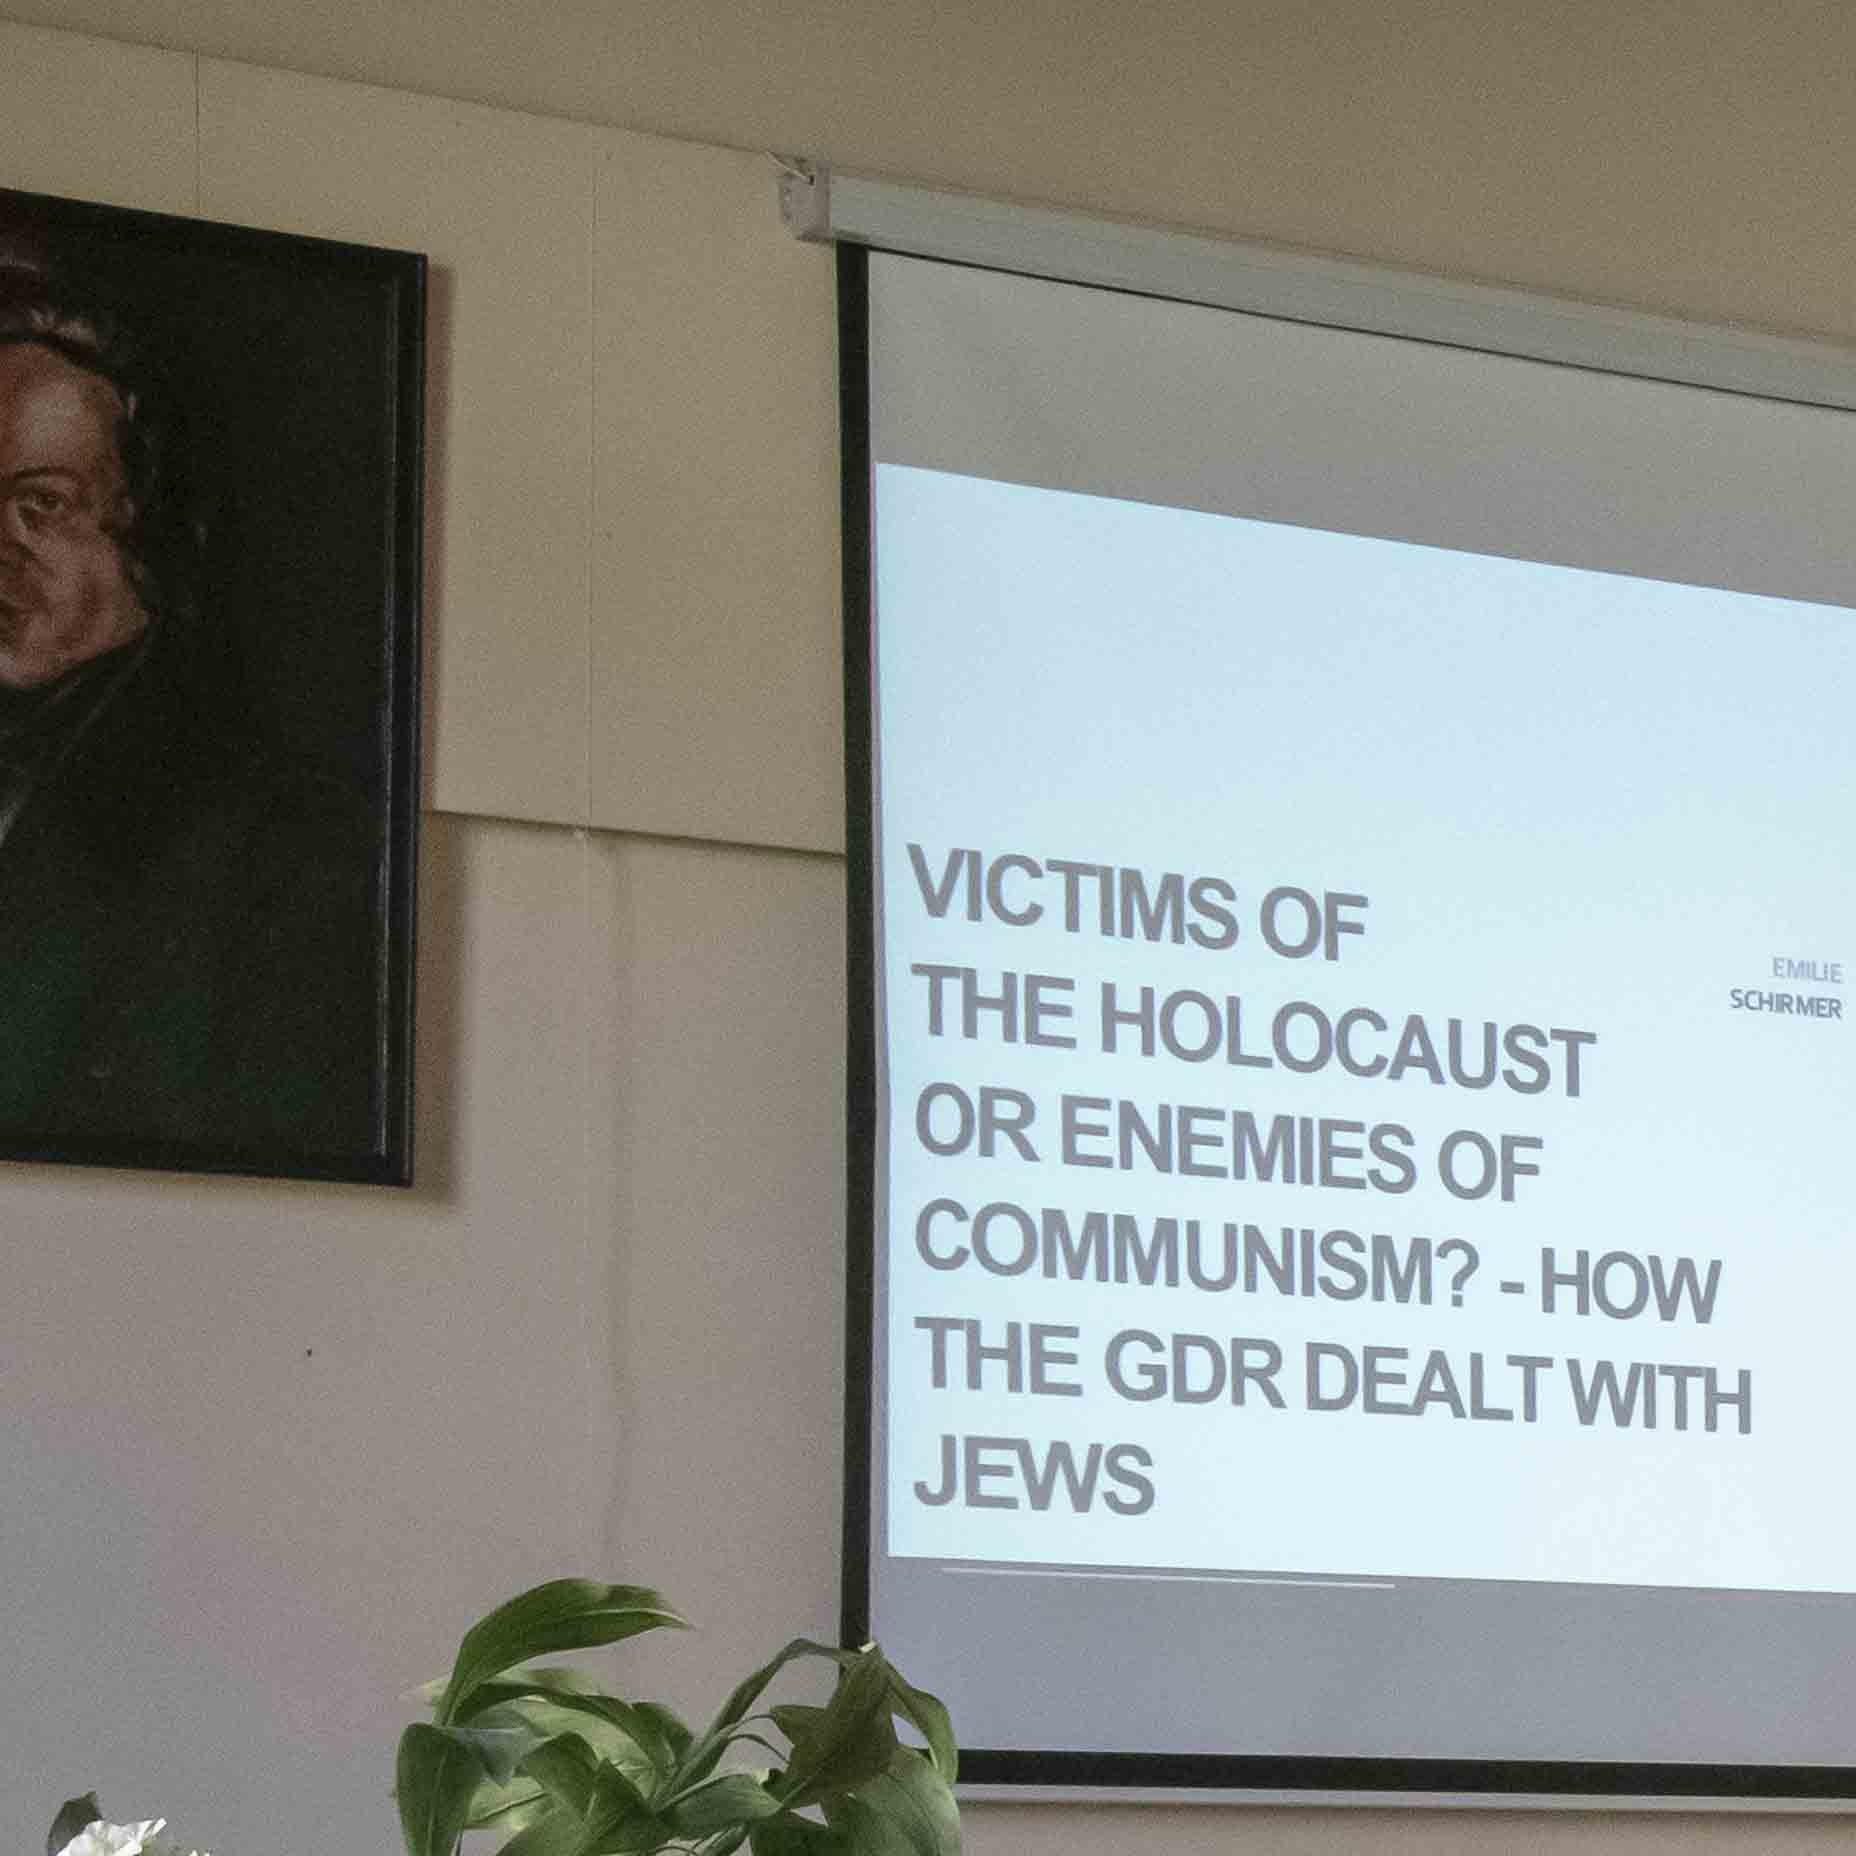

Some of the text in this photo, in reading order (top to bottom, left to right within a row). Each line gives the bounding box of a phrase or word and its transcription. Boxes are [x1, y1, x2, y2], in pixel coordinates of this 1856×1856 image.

[907, 843, 1369, 961] VICTIMS OF
[1730, 988, 1842, 1019] SCHIRMER
[1773, 956, 1842, 984] EMILIE
[911, 963, 1597, 1097] THE HOLOCAUST
[916, 1082, 1543, 1202] OR ENEMIES OF
[915, 1199, 1480, 1307] COMMUNISM?
[1541, 1248, 1722, 1324] HOW
[915, 1317, 1751, 1435] THE GDR DEALT WITH
[914, 1435, 1155, 1516] JEWS
